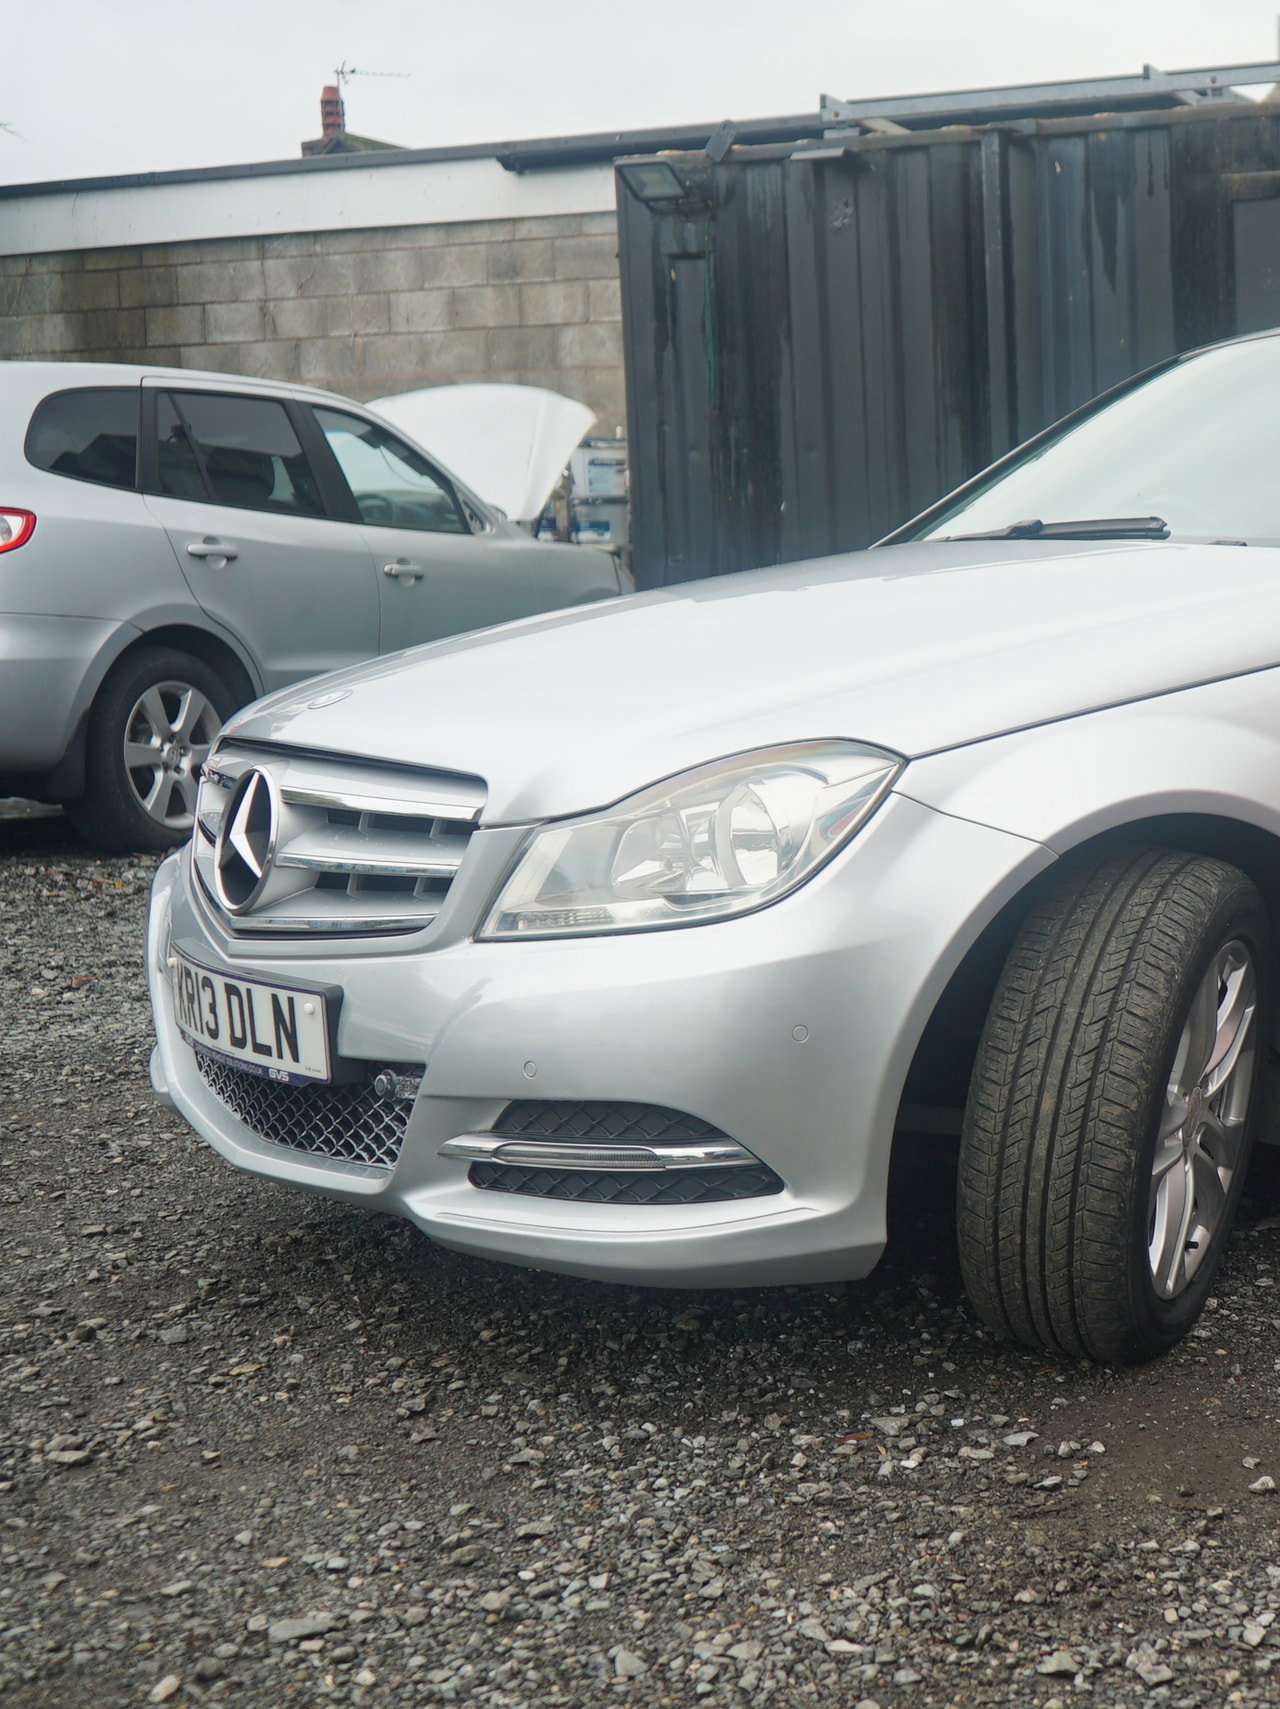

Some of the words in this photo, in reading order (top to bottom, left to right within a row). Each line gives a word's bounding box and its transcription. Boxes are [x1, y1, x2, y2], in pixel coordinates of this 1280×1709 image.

[177, 961, 219, 1040] KR13
[224, 982, 299, 1063] DLN
[268, 1068, 289, 1082] GVS
